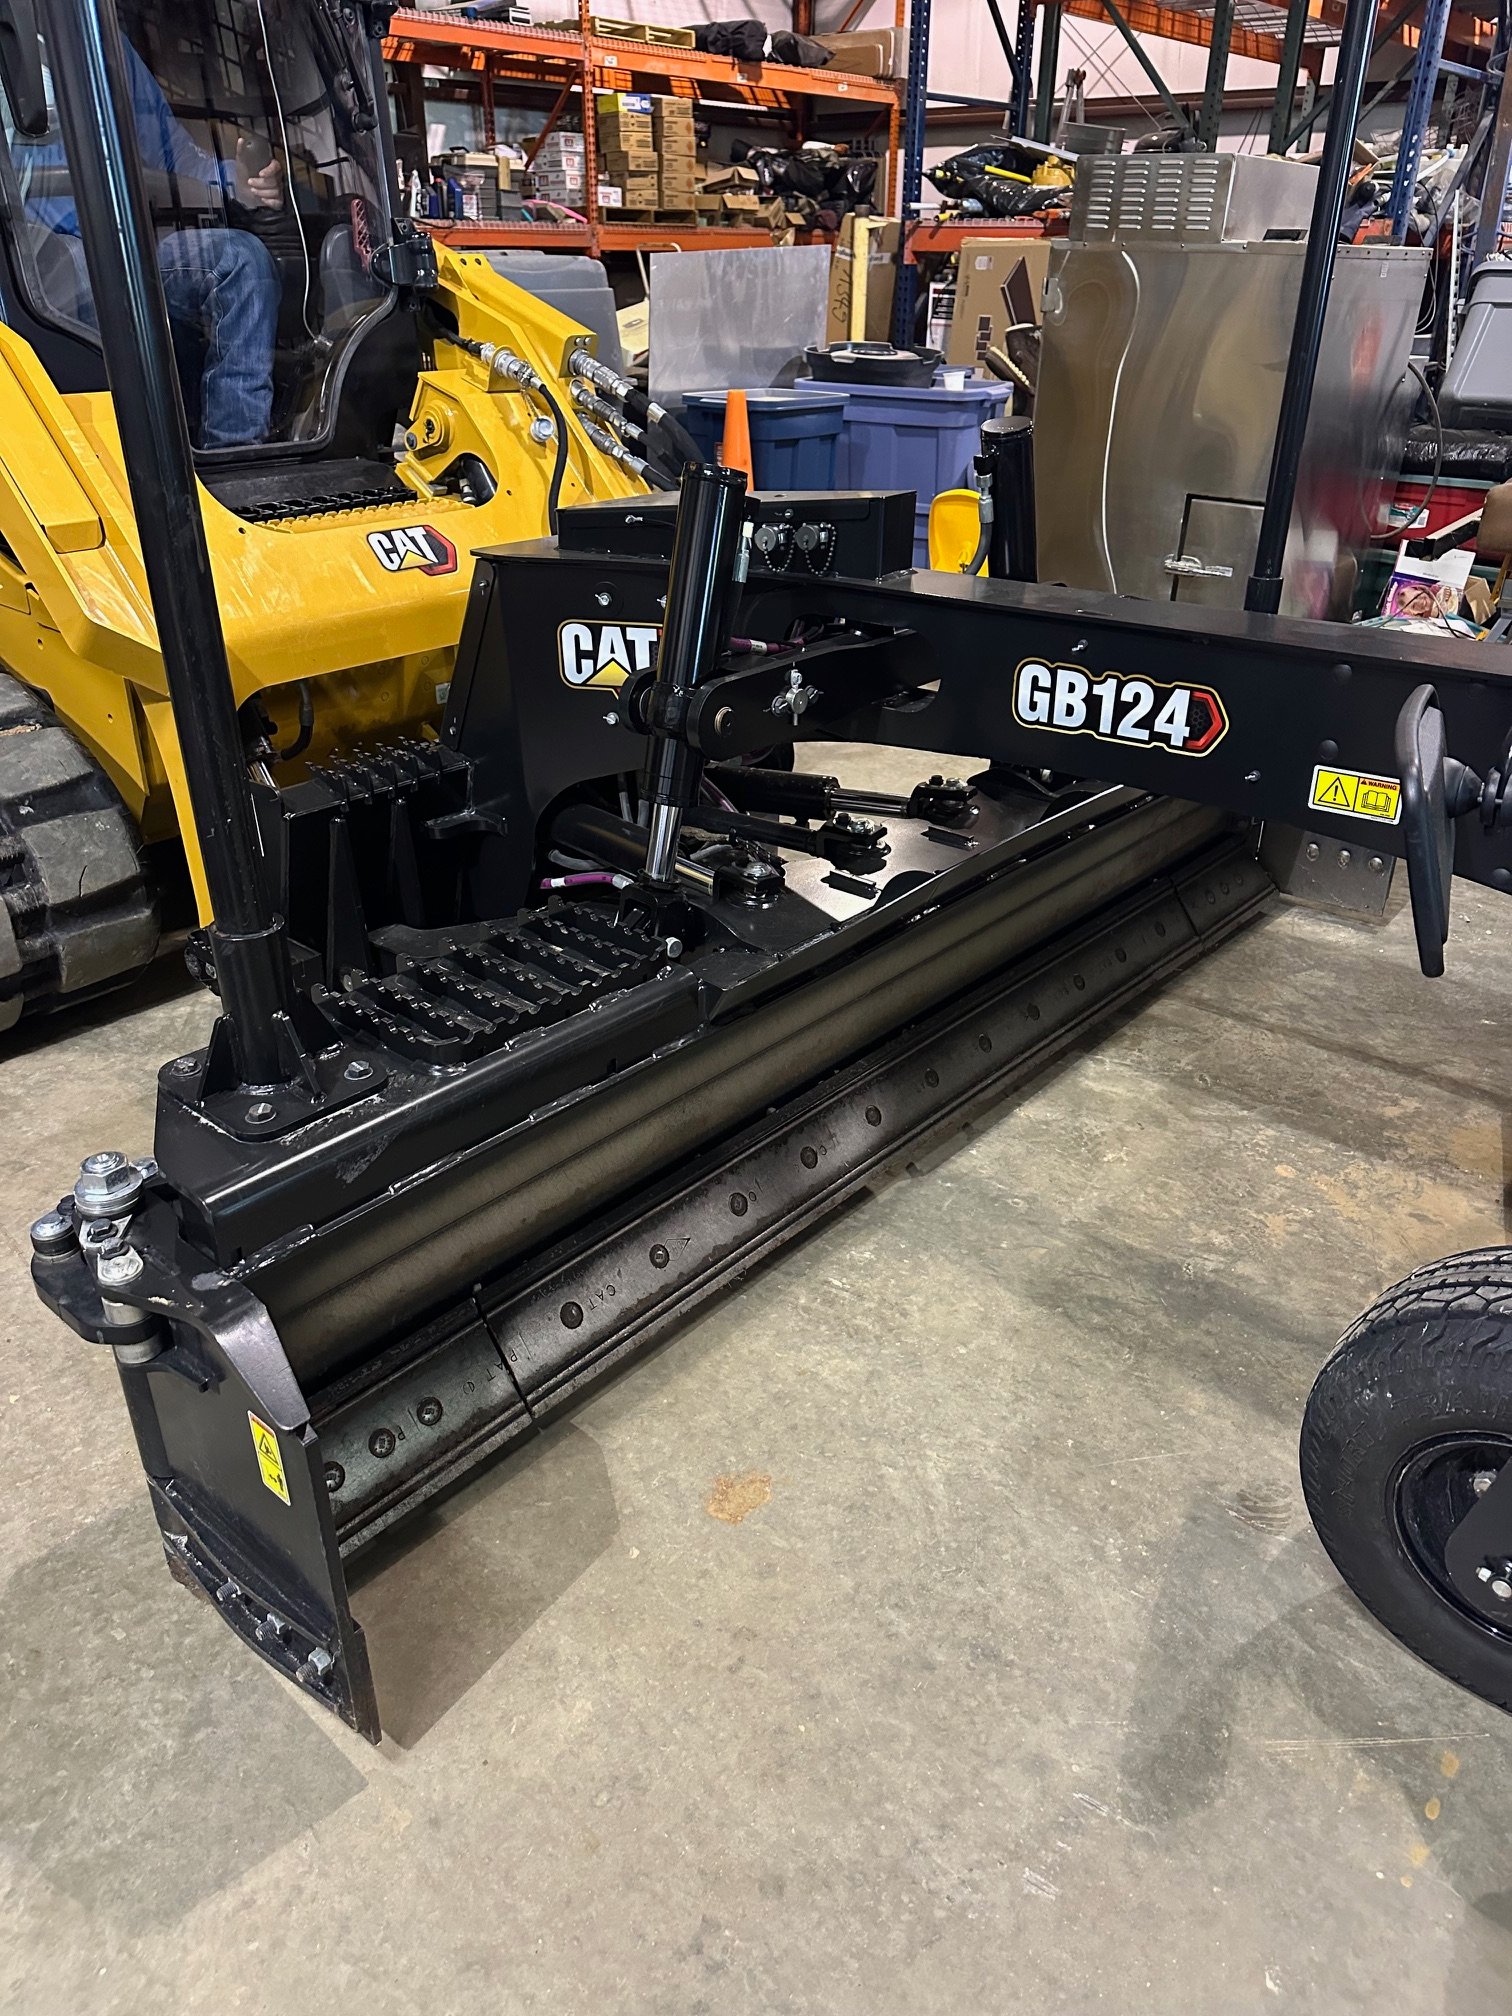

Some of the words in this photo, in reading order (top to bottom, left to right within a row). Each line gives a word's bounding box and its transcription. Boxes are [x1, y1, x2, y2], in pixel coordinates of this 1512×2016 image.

[368, 526, 439, 571] CAT
[562, 623, 658, 684] CAT
[1017, 664, 1191, 748] GB124
[1367, 781, 1398, 791] WARNING
